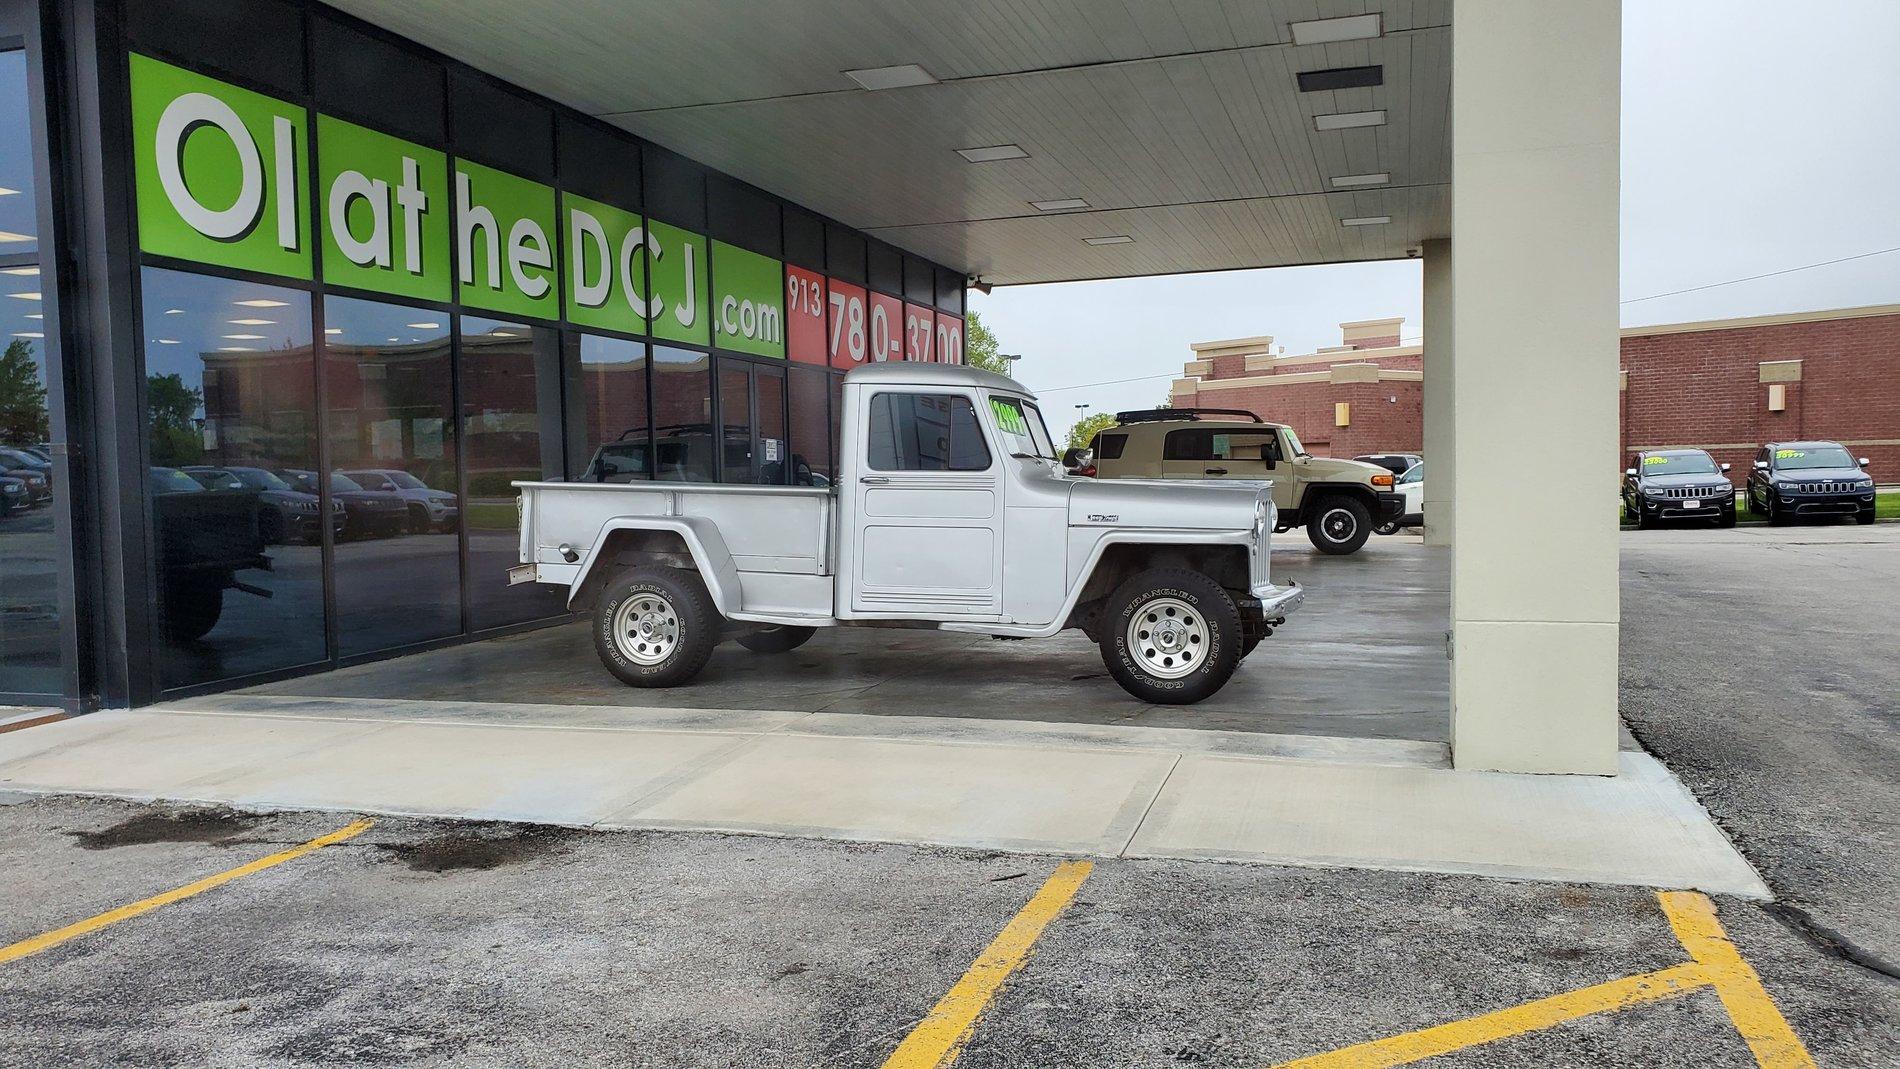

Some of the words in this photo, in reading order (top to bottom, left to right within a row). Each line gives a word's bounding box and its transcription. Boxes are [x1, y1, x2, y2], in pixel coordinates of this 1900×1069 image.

[788, 274, 822, 317] 913
[630, 584, 673, 603] RADIAL
[1122, 588, 1199, 618] WRANGLER
[603, 599, 627, 667] WRANGLER
[1200, 620, 1220, 674] RADIAL
[1116, 636, 1185, 689] GOODYEAR
